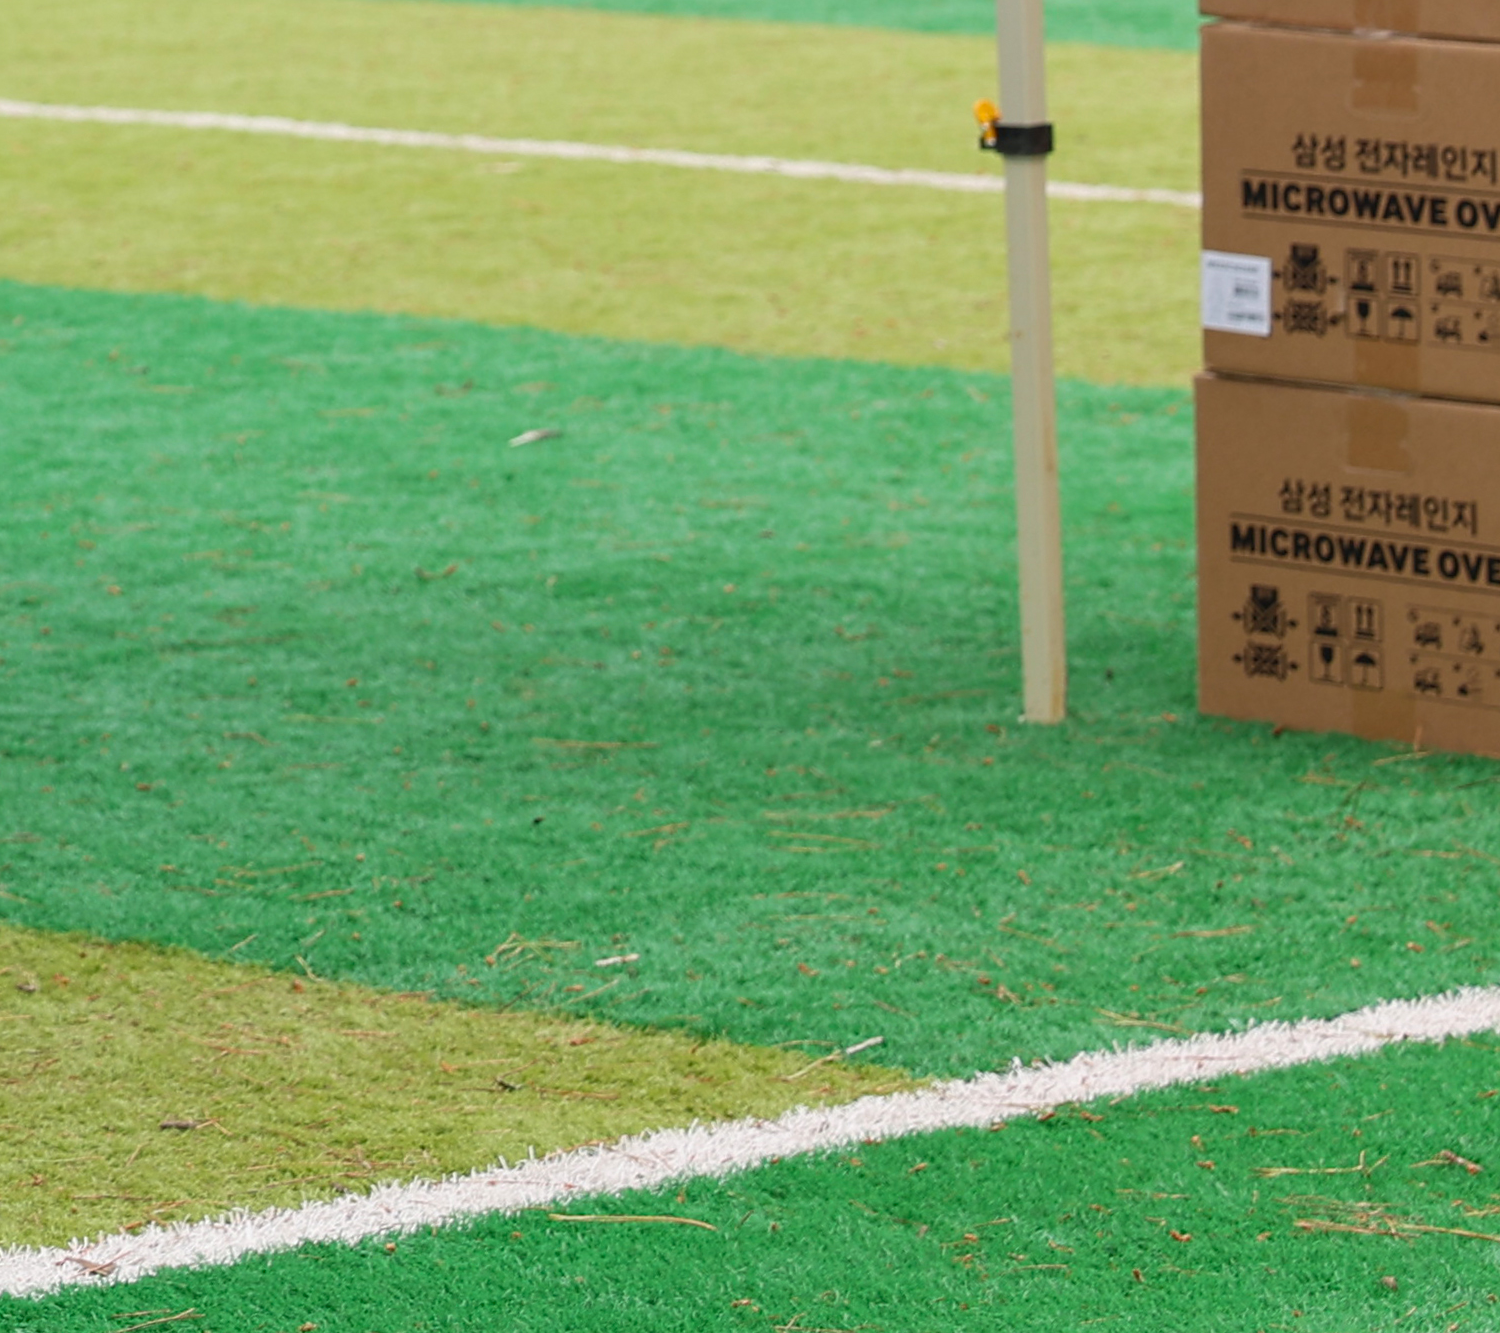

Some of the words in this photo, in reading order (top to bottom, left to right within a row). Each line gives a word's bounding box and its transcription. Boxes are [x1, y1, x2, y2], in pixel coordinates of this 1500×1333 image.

[1291, 133, 1346, 171] 삼성
[1355, 137, 1498, 185] 전자레인지
[1242, 181, 1447, 226] MICROWAVE
[1279, 478, 1331, 517] 삼성
[1341, 485, 1478, 536] 전자레인지
[1231, 522, 1430, 576] MICROWAVE
